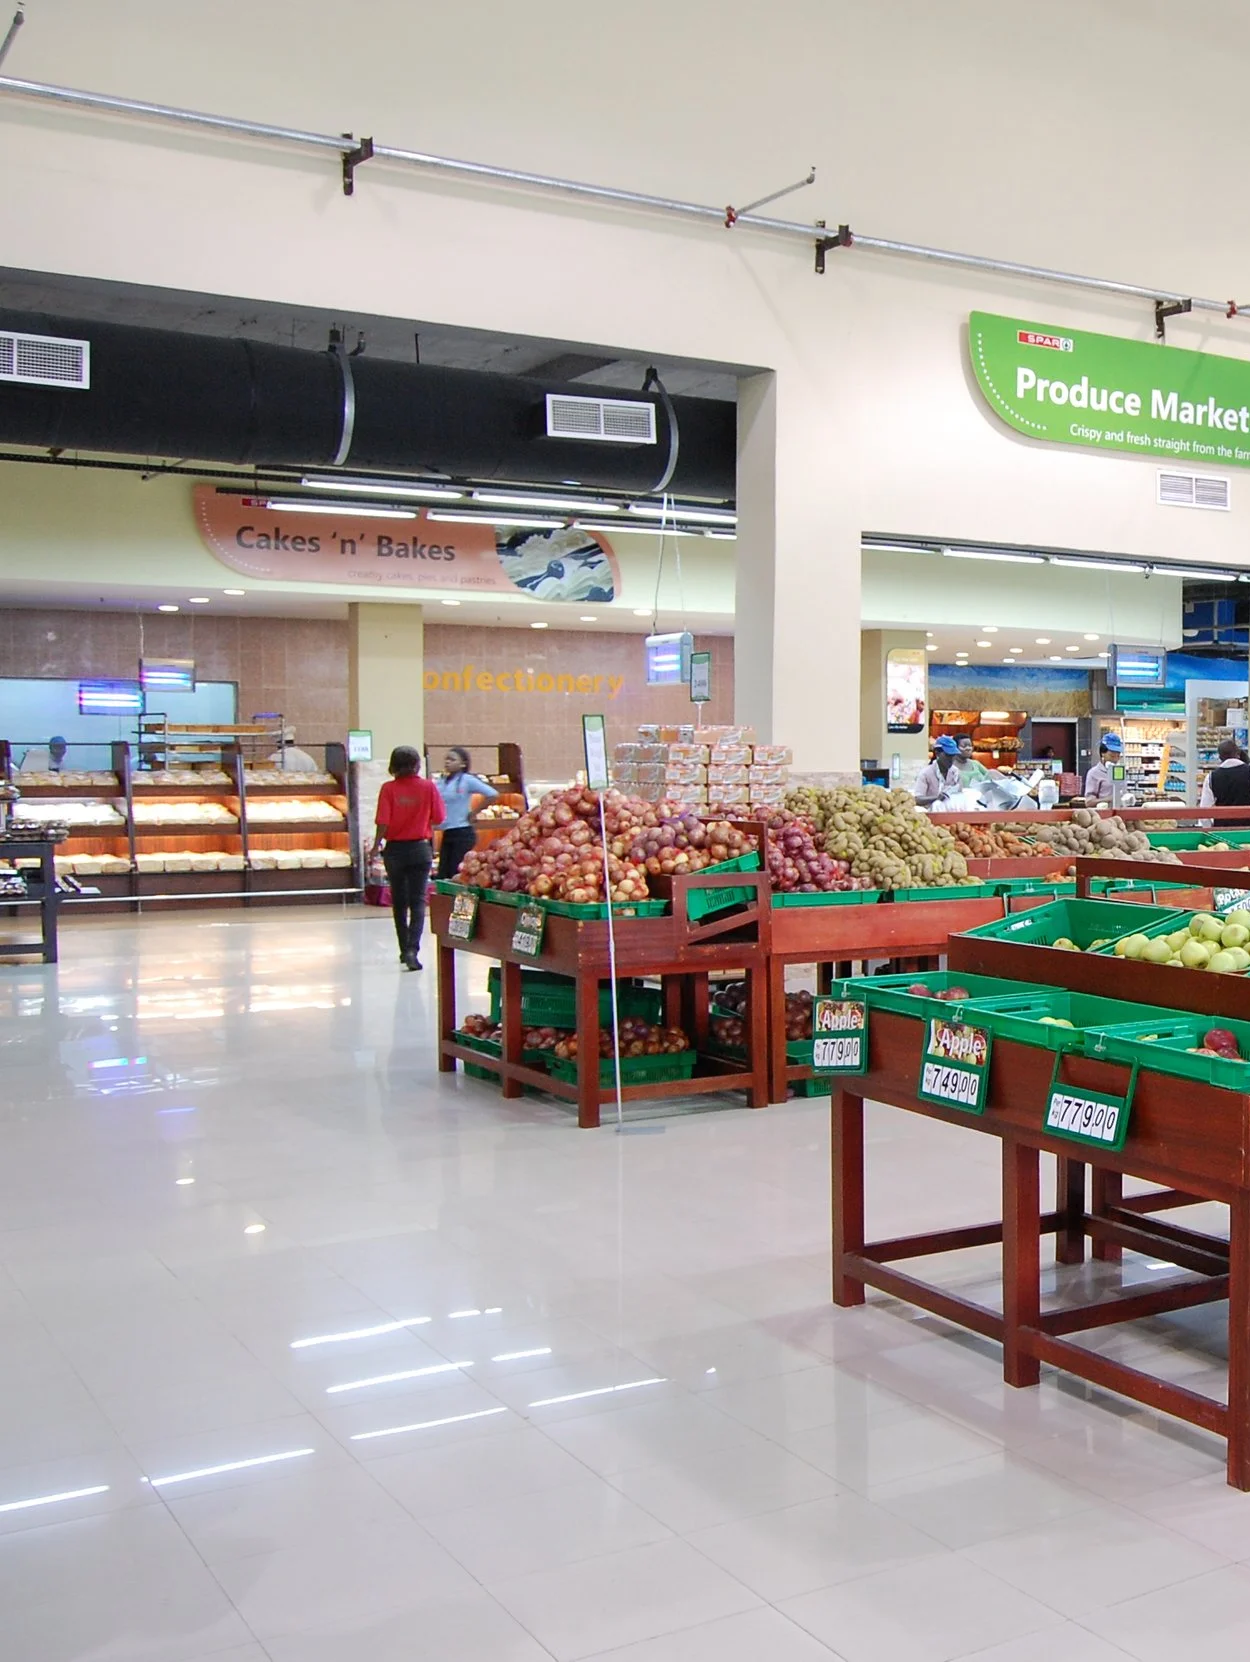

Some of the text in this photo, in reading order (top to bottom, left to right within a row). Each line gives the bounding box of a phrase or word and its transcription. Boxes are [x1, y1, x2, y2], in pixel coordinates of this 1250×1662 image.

[1027, 333, 1060, 349] SPAR
[1016, 366, 1250, 434] Produce Market
[1069, 423, 1102, 443] Crispy
[1104, 429, 1124, 443] and
[1126, 431, 1151, 446] fresh
[1153, 436, 1190, 454] straight
[1192, 441, 1215, 455] from
[1217, 445, 1233, 458] the
[235, 525, 321, 553] Cakes
[376, 534, 456, 562] Bakes
[460, 575, 497, 586] pastries
[423, 664, 624, 700] onfectionery
[822, 1010, 859, 1031] Apple
[822, 1041, 859, 1061] 779.00
[938, 1028, 983, 1057] Apple
[931, 1068, 978, 1096] 749.00
[1060, 1099, 1116, 1130] 779.00
